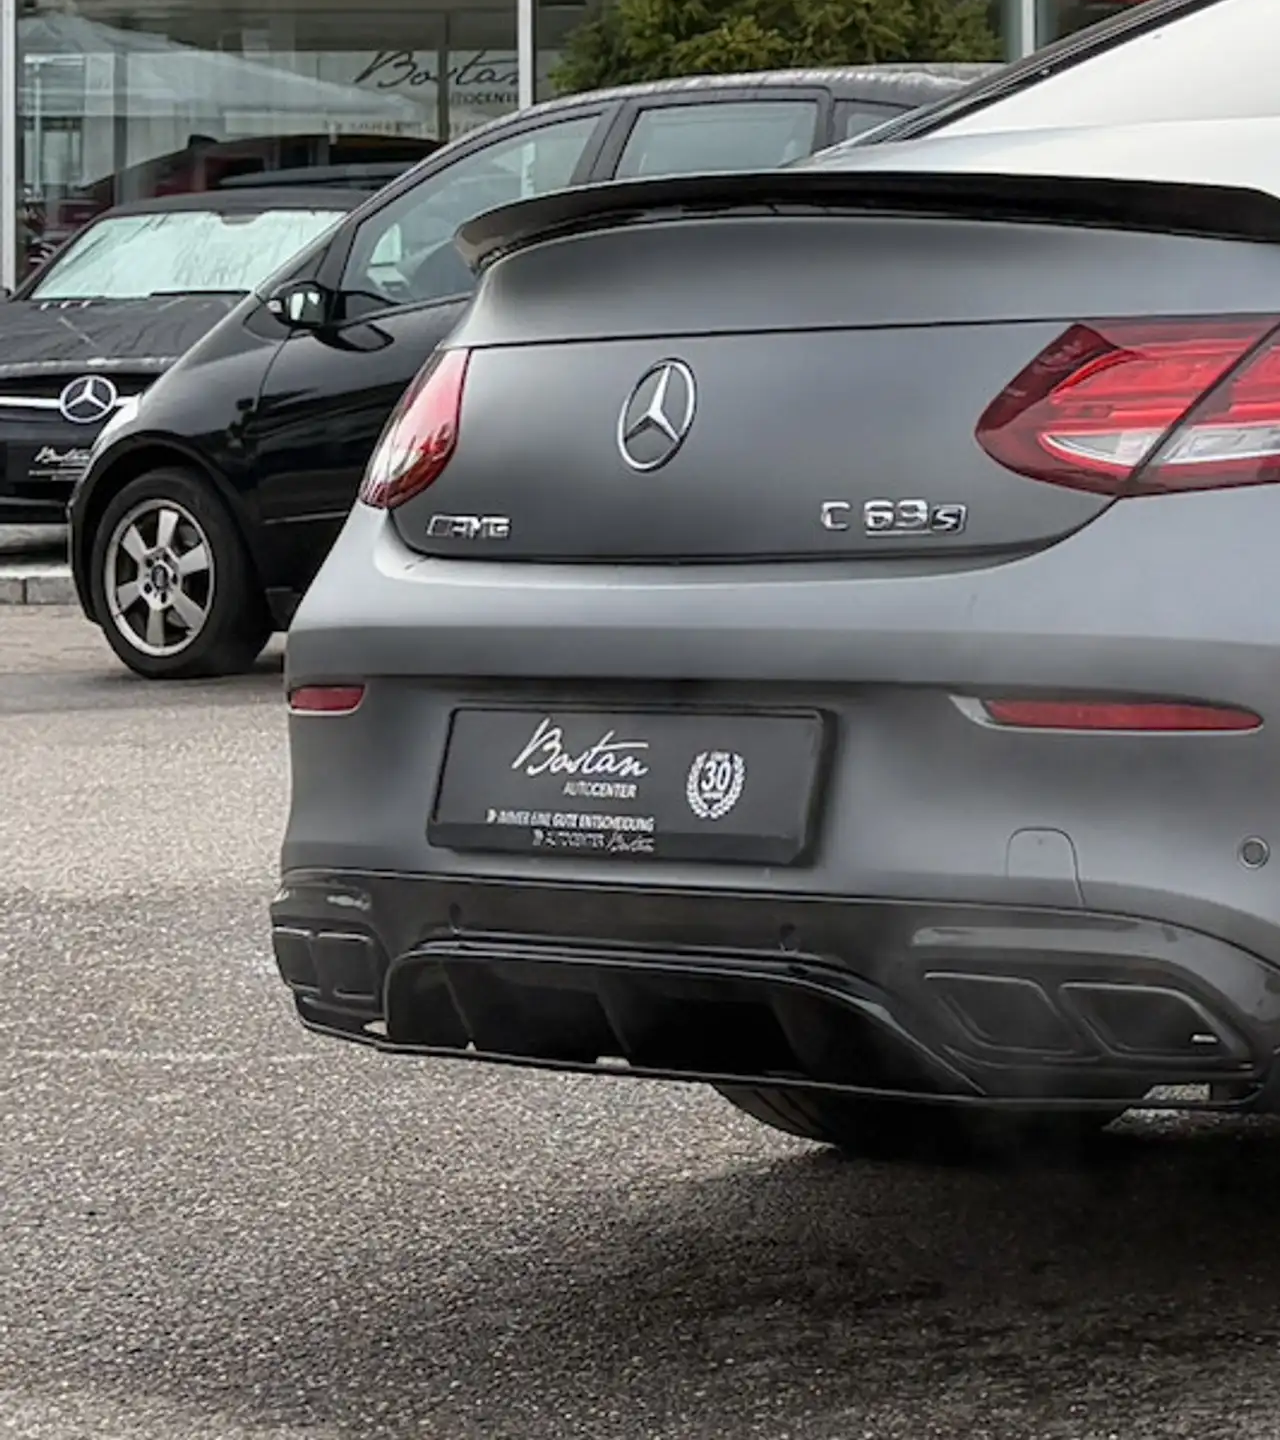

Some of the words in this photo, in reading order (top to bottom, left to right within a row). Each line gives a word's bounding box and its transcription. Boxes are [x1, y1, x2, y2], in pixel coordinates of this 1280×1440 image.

[820, 500, 851, 531] C
[512, 716, 649, 777] Bostan
[563, 781, 638, 799] AUTOCENTER
[700, 760, 731, 791] 30
